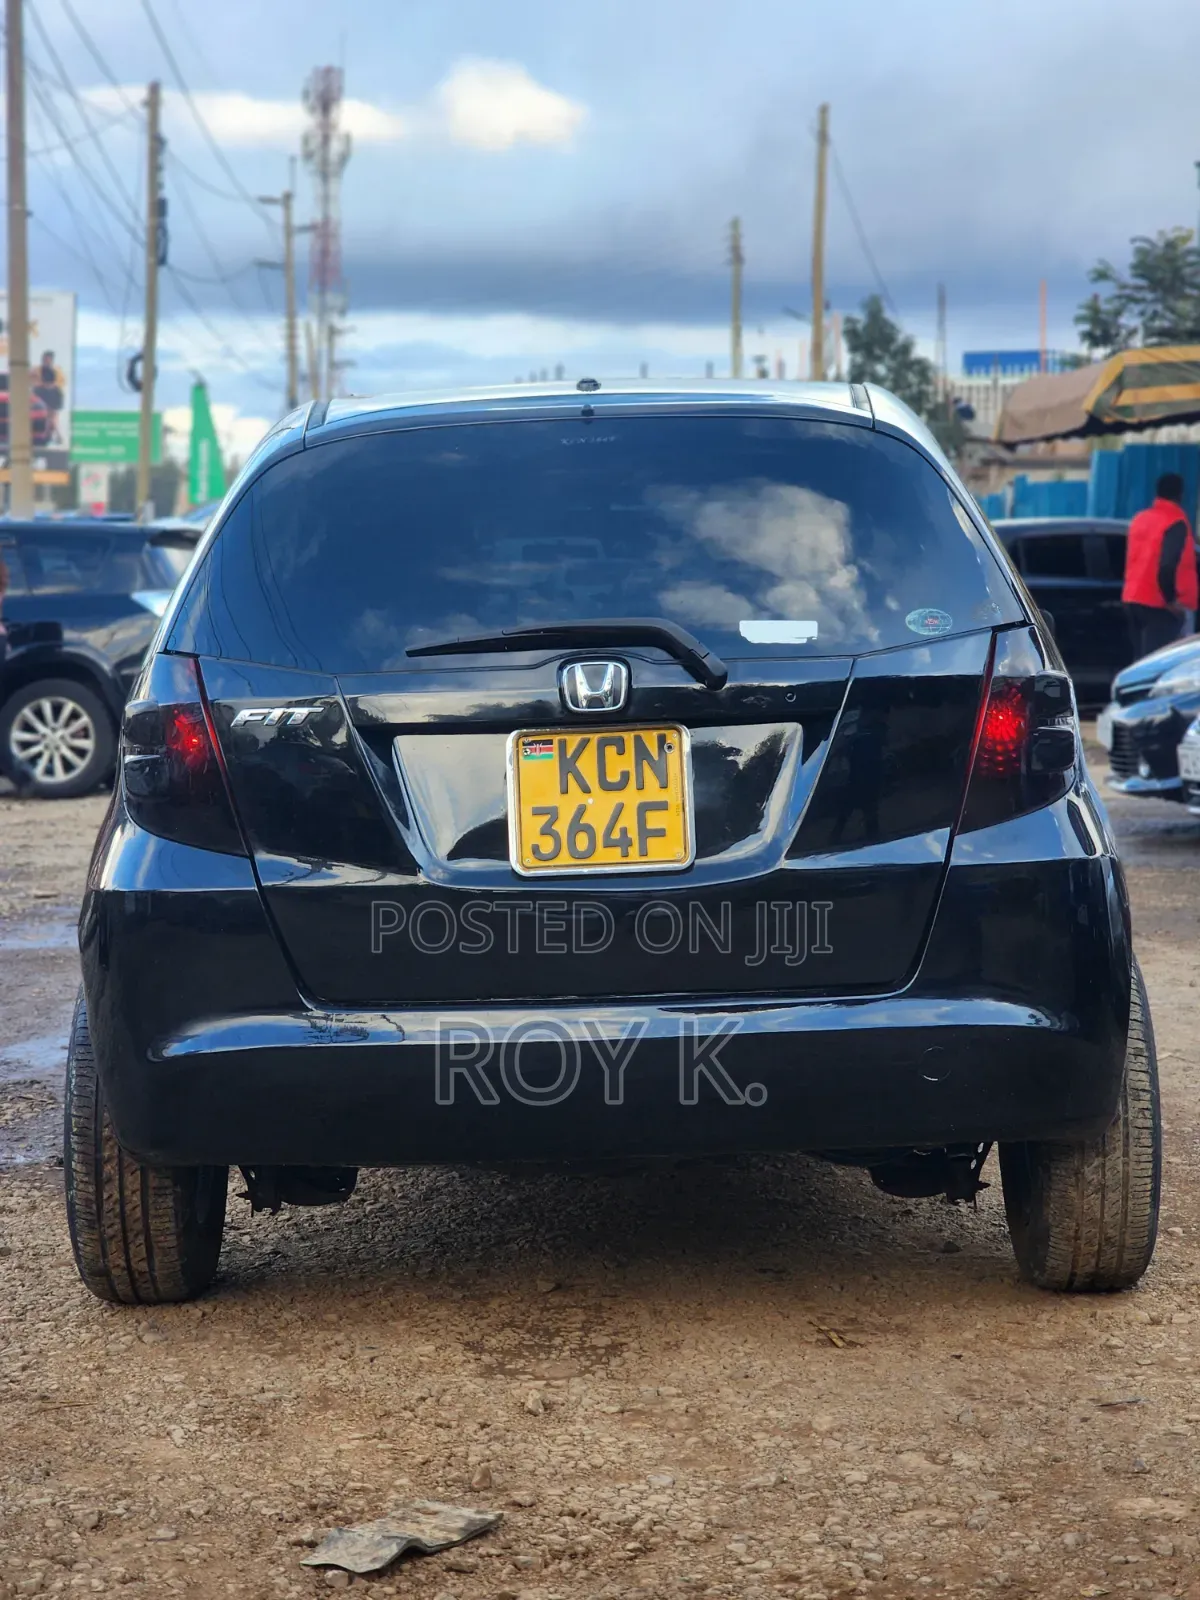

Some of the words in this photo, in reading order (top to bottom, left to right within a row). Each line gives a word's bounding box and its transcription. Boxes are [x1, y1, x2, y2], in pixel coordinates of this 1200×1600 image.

[230, 707, 324, 728] FIT
[558, 733, 669, 794] KCN
[531, 800, 669, 861] 364F
